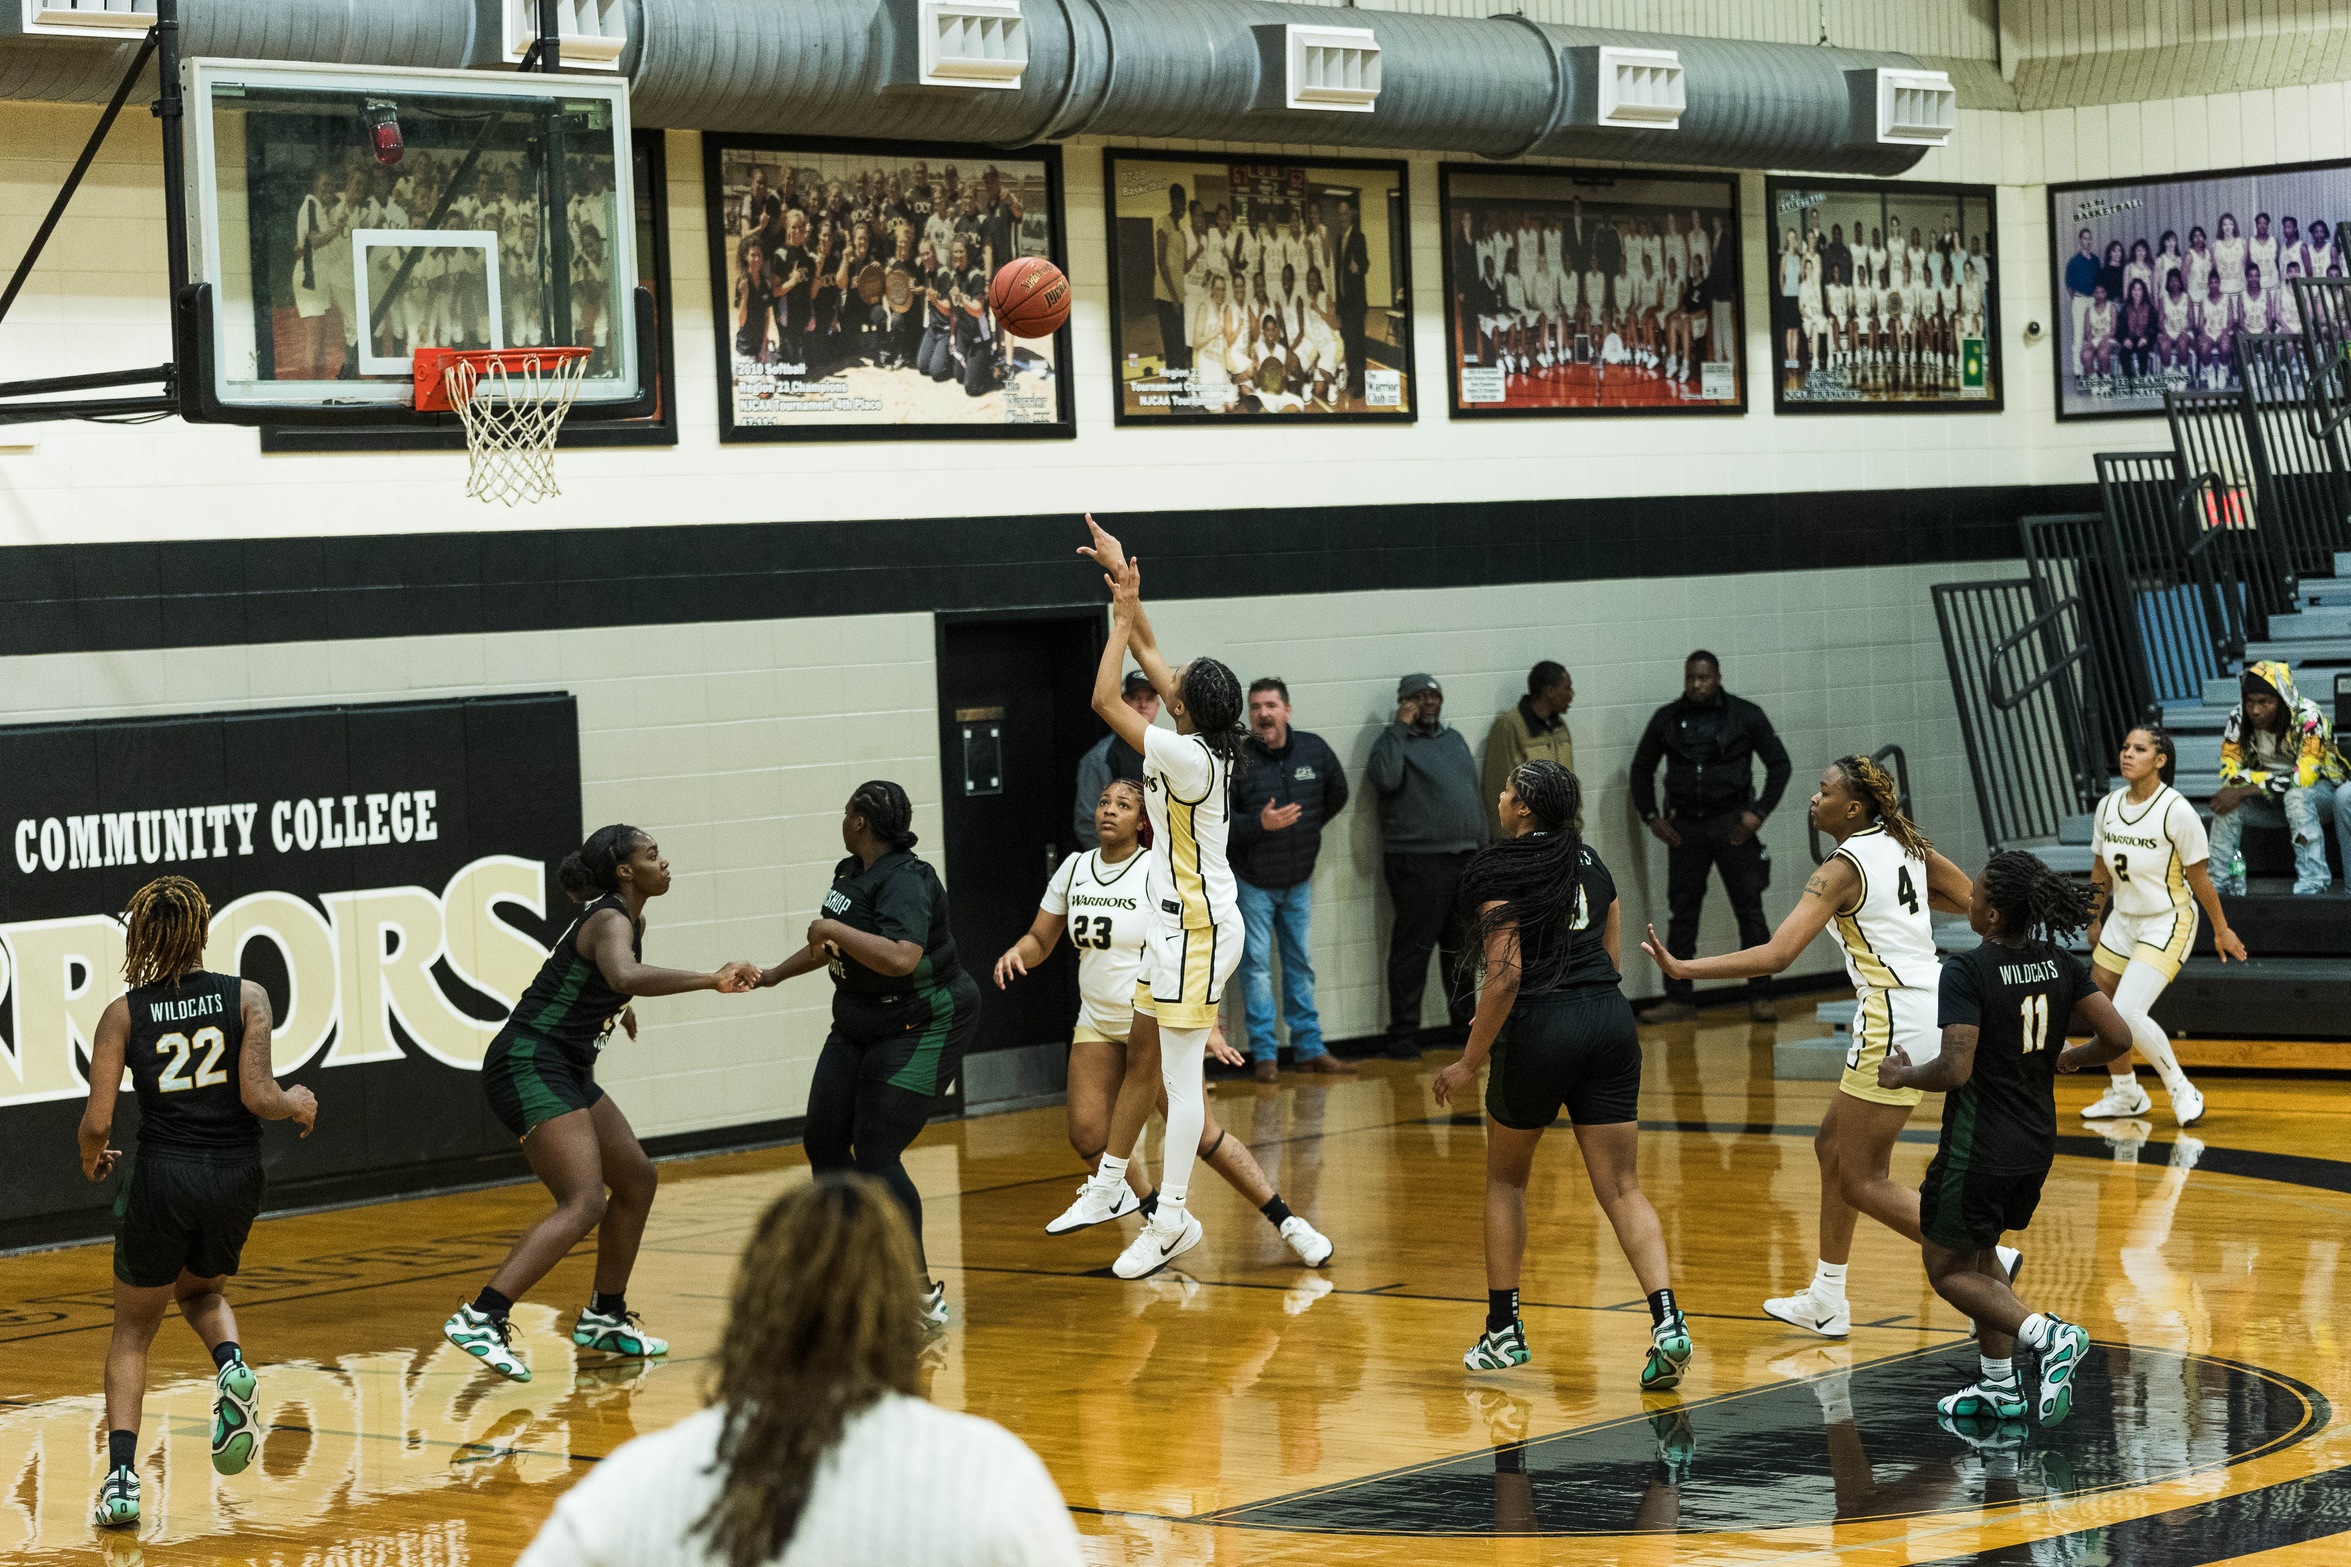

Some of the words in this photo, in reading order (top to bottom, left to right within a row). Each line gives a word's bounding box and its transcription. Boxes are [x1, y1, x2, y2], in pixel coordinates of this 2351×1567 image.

[764, 362, 806, 375] Softball
[1159, 367, 1190, 380] Region
[738, 381, 775, 394] Region
[791, 381, 848, 395] Champions
[1130, 381, 1183, 392] Tournament
[739, 399, 773, 412] NJCAA
[774, 399, 834, 412] Tournament
[835, 399, 853, 411] 4th
[854, 399, 883, 411] Place
[14, 803, 258, 874] COMMUNITY
[271, 790, 438, 853] COLLEGE
[2103, 832, 2158, 850] WARRIORS
[2113, 852, 2132, 882] 2
[1071, 894, 1137, 911] WARRIORS
[1897, 864, 1920, 916] 4
[1073, 914, 1113, 951] 23
[1999, 959, 2059, 986] WILDCATS
[150, 993, 223, 1023] WILDCATS
[2020, 993, 2049, 1055] 11
[156, 1025, 229, 1094] 22
